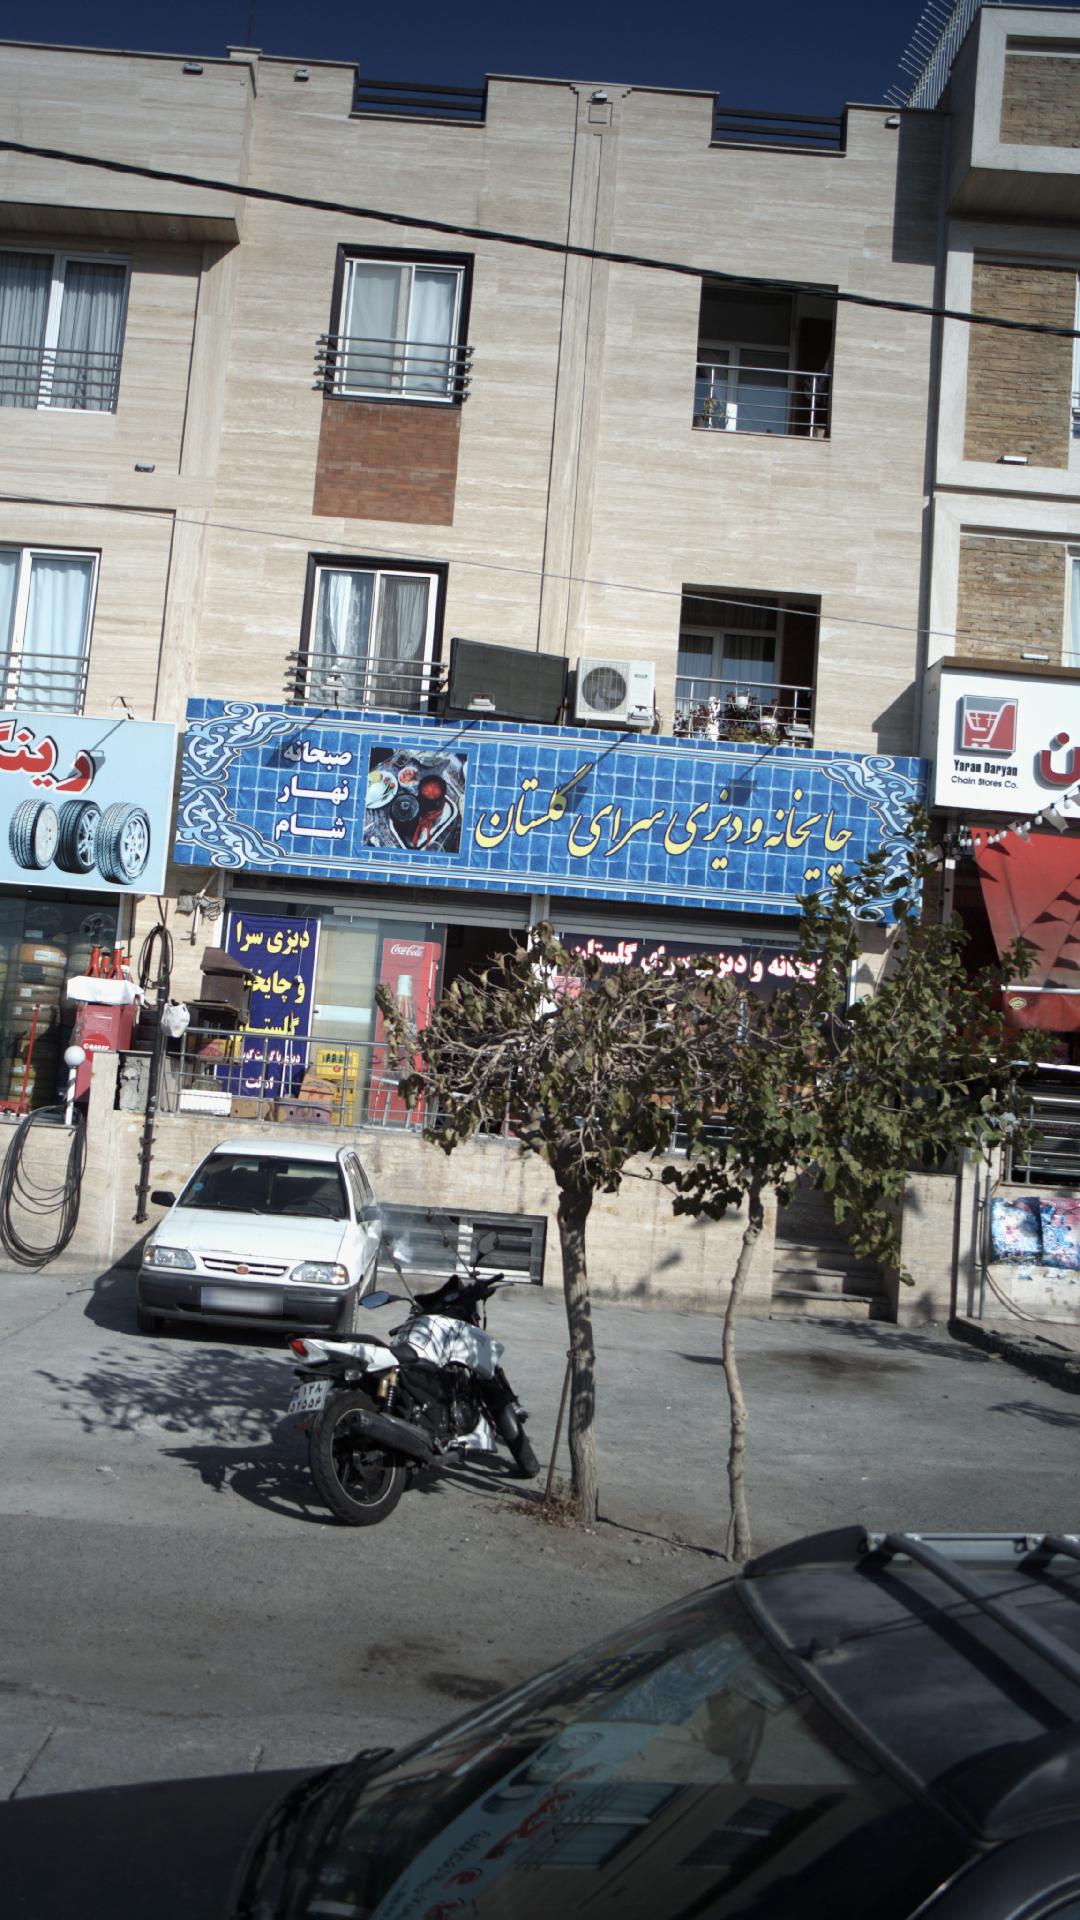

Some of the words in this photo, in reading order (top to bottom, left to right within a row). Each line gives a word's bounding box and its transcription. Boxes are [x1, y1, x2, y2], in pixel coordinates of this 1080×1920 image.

[282, 740, 353, 768] صبحانه
[953, 759, 982, 773] Yaran
[984, 762, 1018, 778] Daryan
[276, 774, 350, 804] نهار
[951, 775, 977, 786] Chain
[978, 777, 1002, 788] Stores
[1004, 780, 1019, 789] Co.
[474, 763, 593, 849] گلستان
[275, 813, 347, 841] شام
[567, 803, 665, 858] سرای
[664, 787, 742, 871] دیزی
[763, 787, 853, 884] چایخانه
[237, 920, 264, 952] سرا
[267, 929, 310, 955] دیزی
